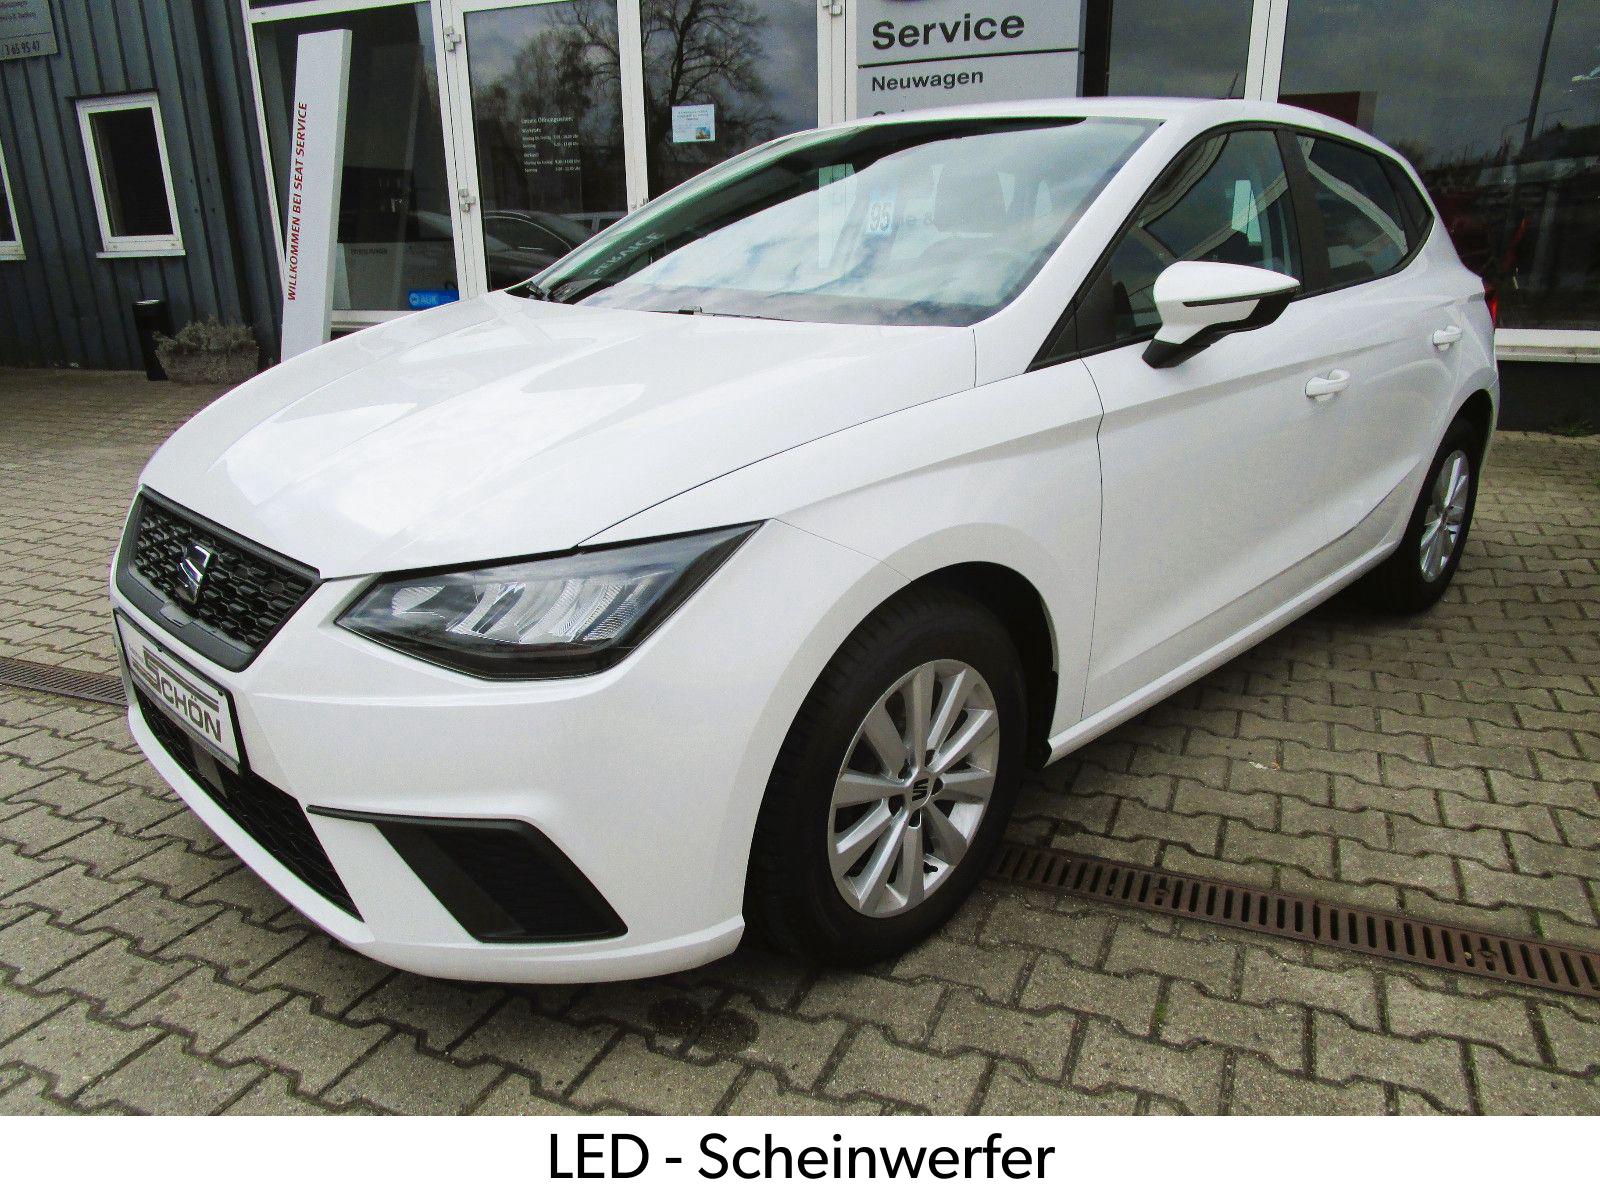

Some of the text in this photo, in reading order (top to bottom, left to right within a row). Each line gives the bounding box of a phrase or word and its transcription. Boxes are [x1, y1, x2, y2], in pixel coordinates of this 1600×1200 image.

[873, 13, 1025, 51] Service
[872, 70, 984, 92] Neuwagen
[288, 102, 308, 301] WILLKOMMEN BEI SEAT SERVICE
